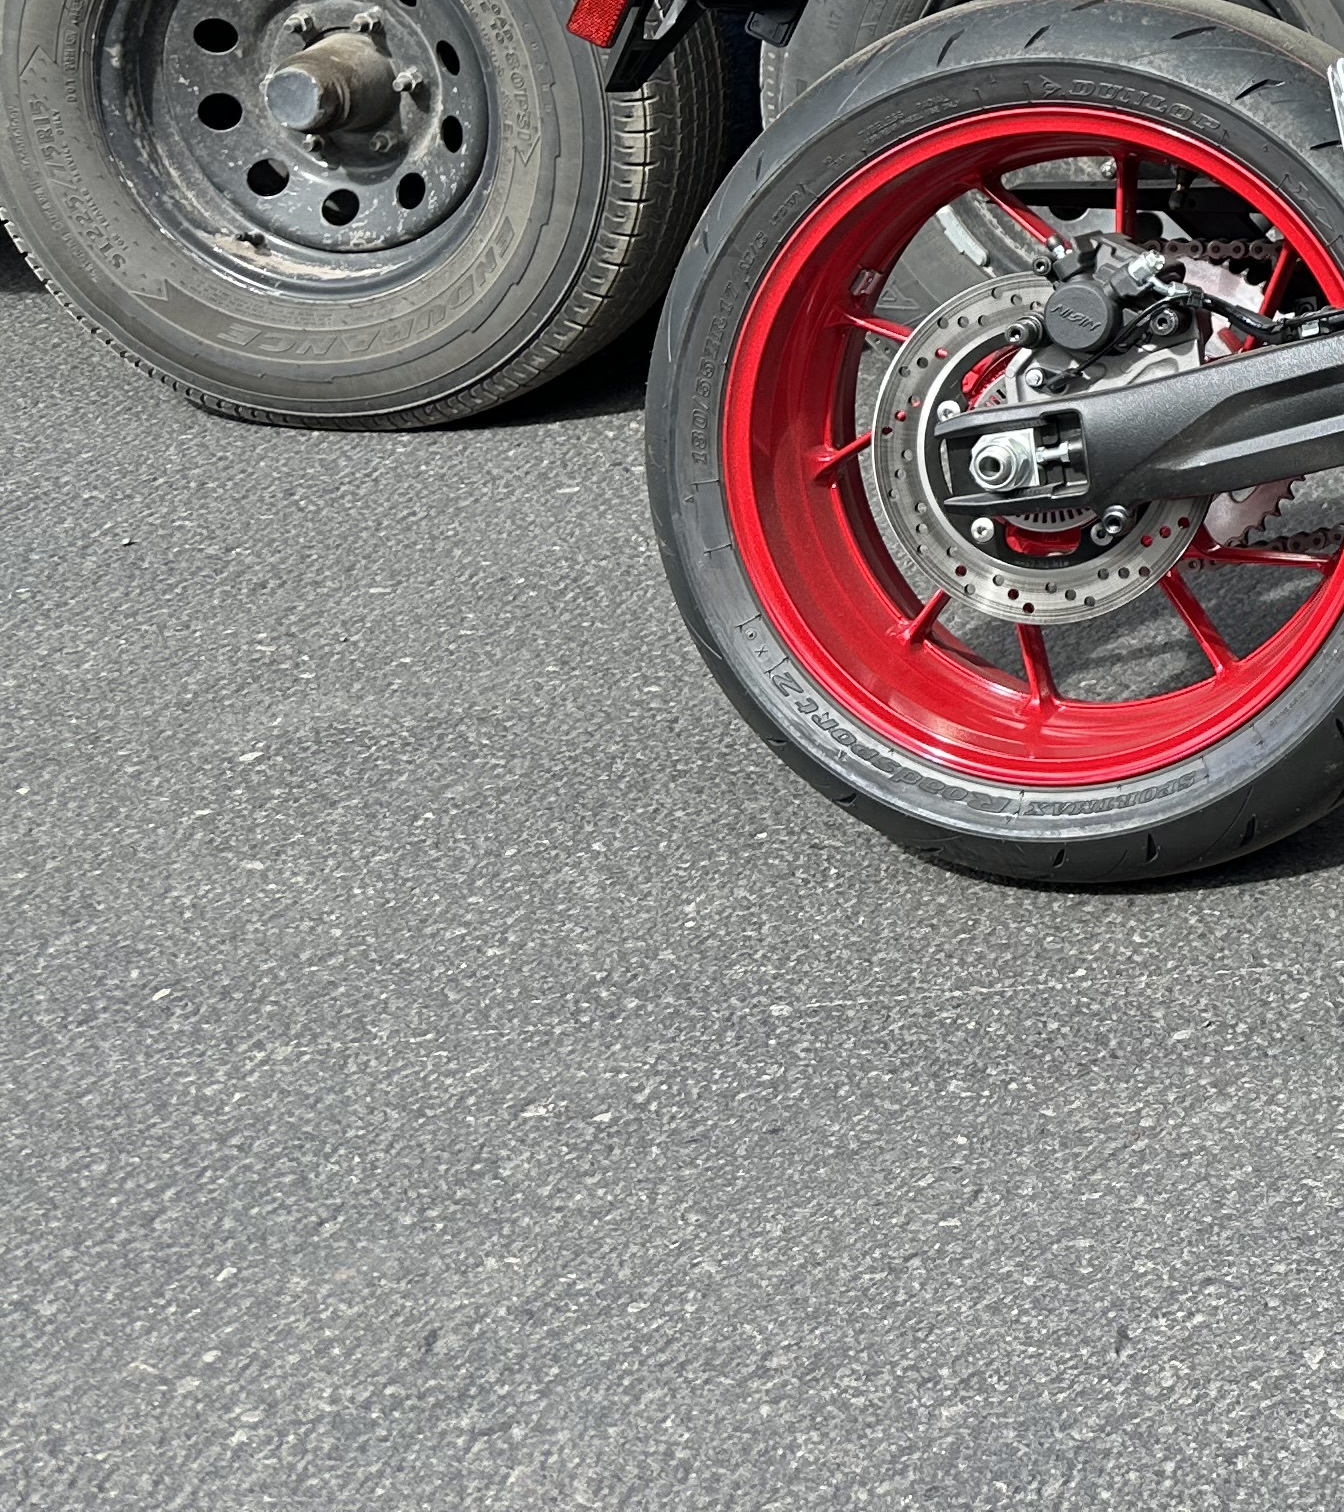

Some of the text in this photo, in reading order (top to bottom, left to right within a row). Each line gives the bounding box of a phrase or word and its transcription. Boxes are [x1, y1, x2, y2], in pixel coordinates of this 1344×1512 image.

[489, 18, 505, 46] TO
[1066, 79, 1225, 138] DUNLOP
[217, 215, 516, 357] ENDURANCE
[768, 670, 805, 699] 2
[1023, 769, 1199, 818] SPORTMAX
